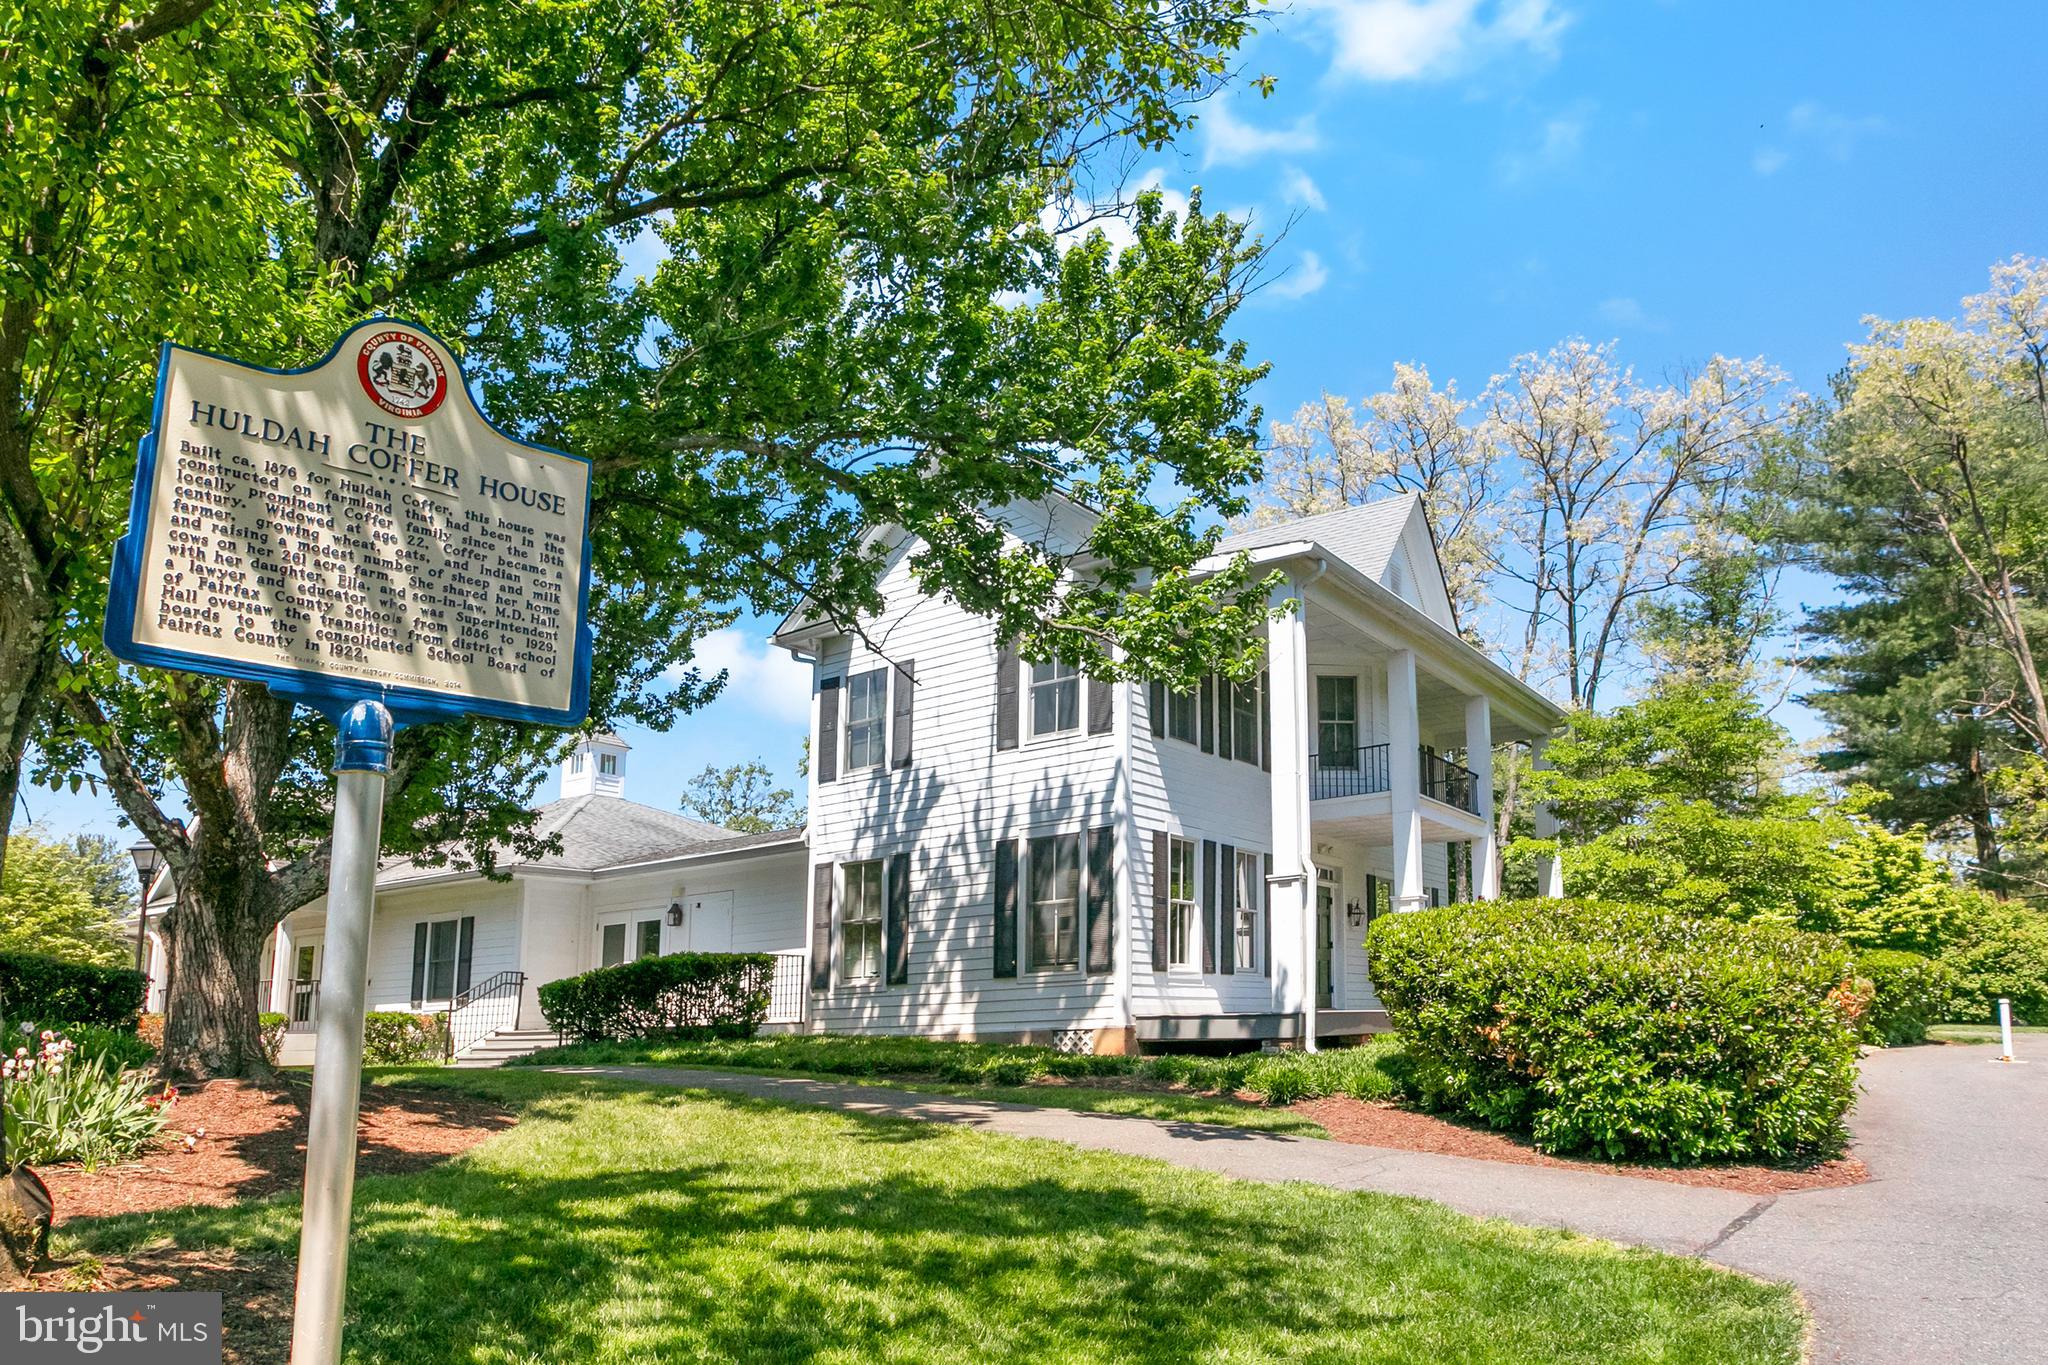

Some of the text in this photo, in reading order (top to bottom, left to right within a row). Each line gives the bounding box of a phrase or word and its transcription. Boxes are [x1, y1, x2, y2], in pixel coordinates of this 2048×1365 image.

[363, 332, 445, 377] COUNTY OF FAIRFAX
[364, 421, 425, 456] THE
[377, 398, 423, 416] VIRGINIA
[180, 440, 565, 542] Built ca. 1876 for Huldah Coffer, this house was
[189, 400, 565, 516] HULDAH COFFER HOUSE
[174, 486, 562, 579] century. Widowed at age 22, Coffer became a
[177, 457, 564, 554] constructed on farmland that had been in the
[177, 468, 564, 567] locally prominent Coffer family since the 18th
[167, 544, 205, 561] with
[213, 550, 242, 568] her
[250, 557, 326, 583] daughter,
[379, 585, 406, 599] and
[495, 605, 525, 621] M.D.
[168, 529, 208, 547] cows
[217, 539, 236, 551] on
[246, 541, 273, 557] her
[281, 549, 306, 566] 261
[313, 558, 346, 574] acre
[408, 575, 434, 590] She
[442, 583, 487, 601] shared
[495, 593, 517, 607] her
[525, 599, 559, 615] home
[170, 514, 560, 603] and raising a modest number of sheep and milk
[255, 518, 319, 543] growing
[331, 533, 388, 553] wheat,
[395, 548, 430, 563] oats,
[443, 559, 469, 571] and
[479, 563, 520, 583] Indian
[532, 578, 561, 591] corn
[157, 613, 367, 661] Fairfax County in 1922.
[159, 598, 555, 677] boards to the consolidated School Board of
[161, 584, 197, 603] Hall
[207, 596, 273, 616] oversaw
[284, 606, 310, 621] the
[407, 629, 443, 645] from
[451, 636, 503, 656] district
[515, 650, 556, 665] school
[163, 572, 557, 652] of Fairfax County Schools from 1886 to 1929.
[164, 558, 558, 641] a lawyer and educator who was Superintendent
[329, 662, 359, 672] COUNTY
